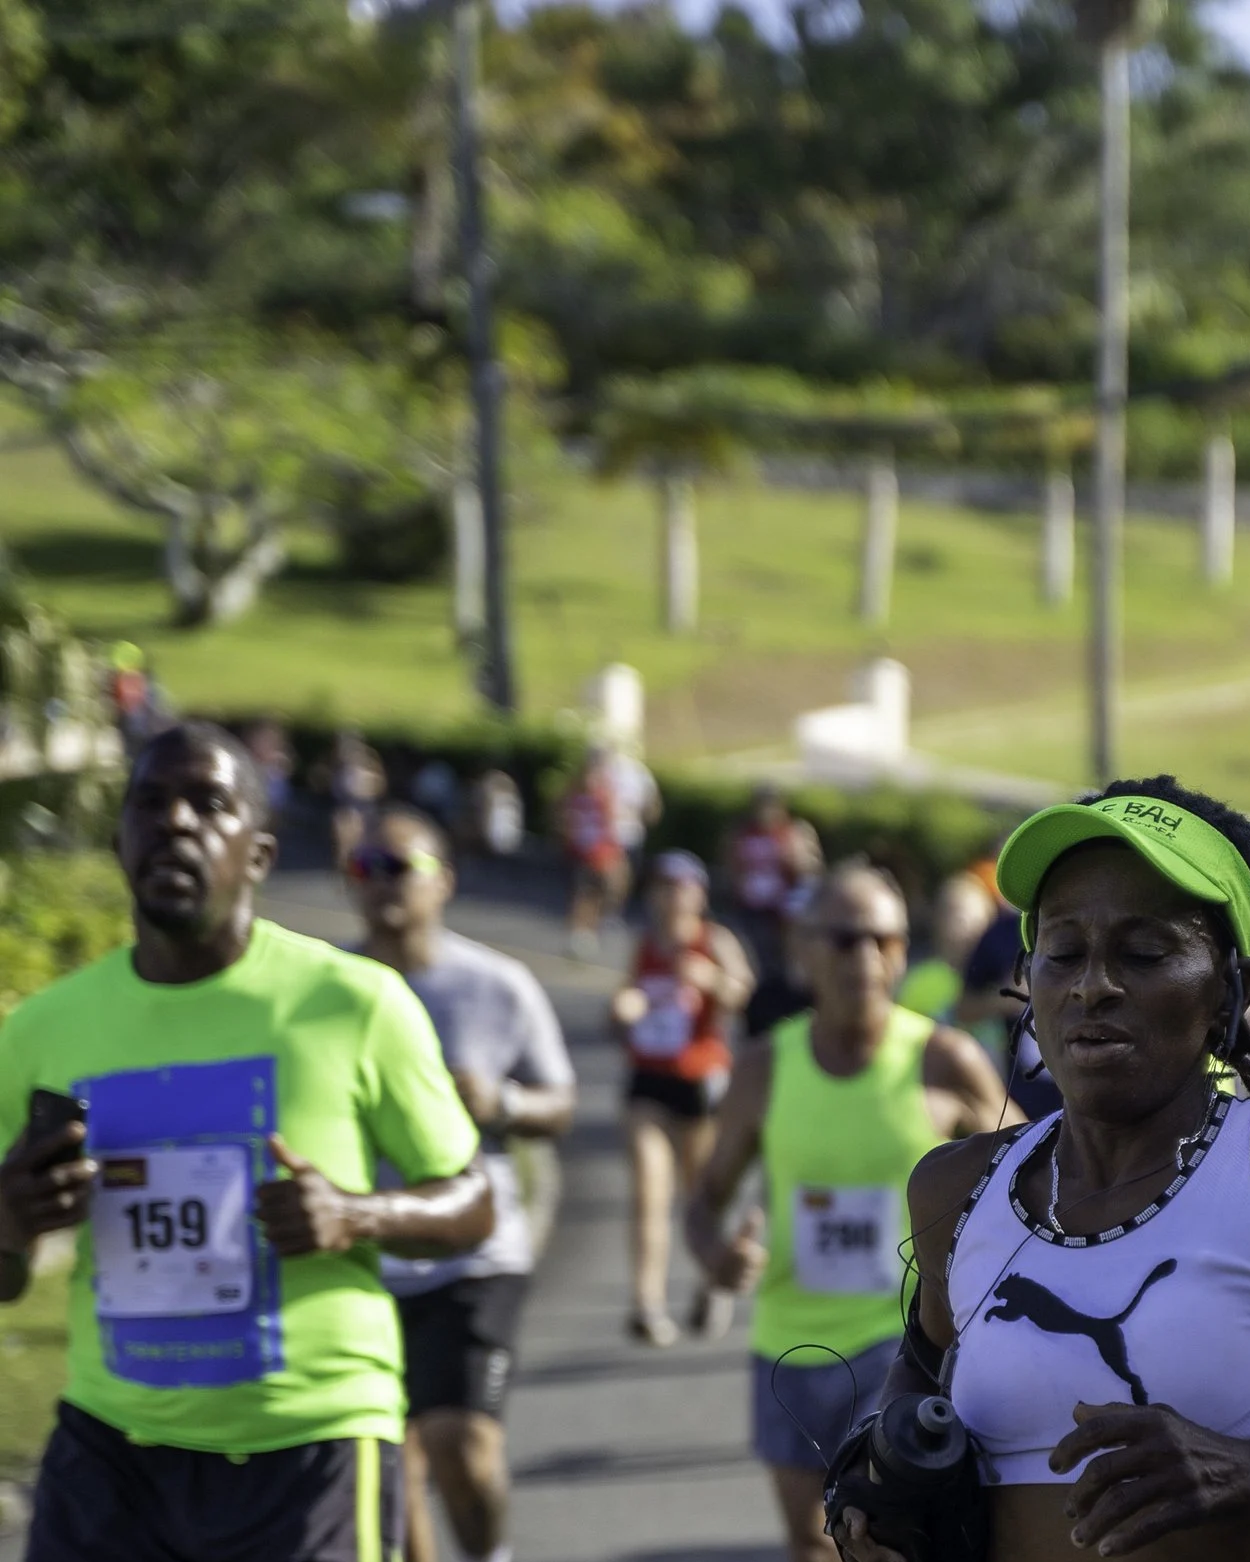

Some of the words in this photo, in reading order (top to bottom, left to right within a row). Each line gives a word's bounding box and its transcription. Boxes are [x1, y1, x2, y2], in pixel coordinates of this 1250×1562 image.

[1124, 802, 1183, 831] BAd
[991, 1143, 1011, 1164] PUMA
[971, 1175, 990, 1200] PUMA
[125, 1198, 207, 1251] 159
[1063, 1236, 1087, 1247] PUMA
[1099, 1225, 1125, 1243] PUMA
[1134, 1203, 1160, 1225] PUMA
[1165, 1174, 1187, 1197] PUMA
[953, 1211, 969, 1239] PUMA
